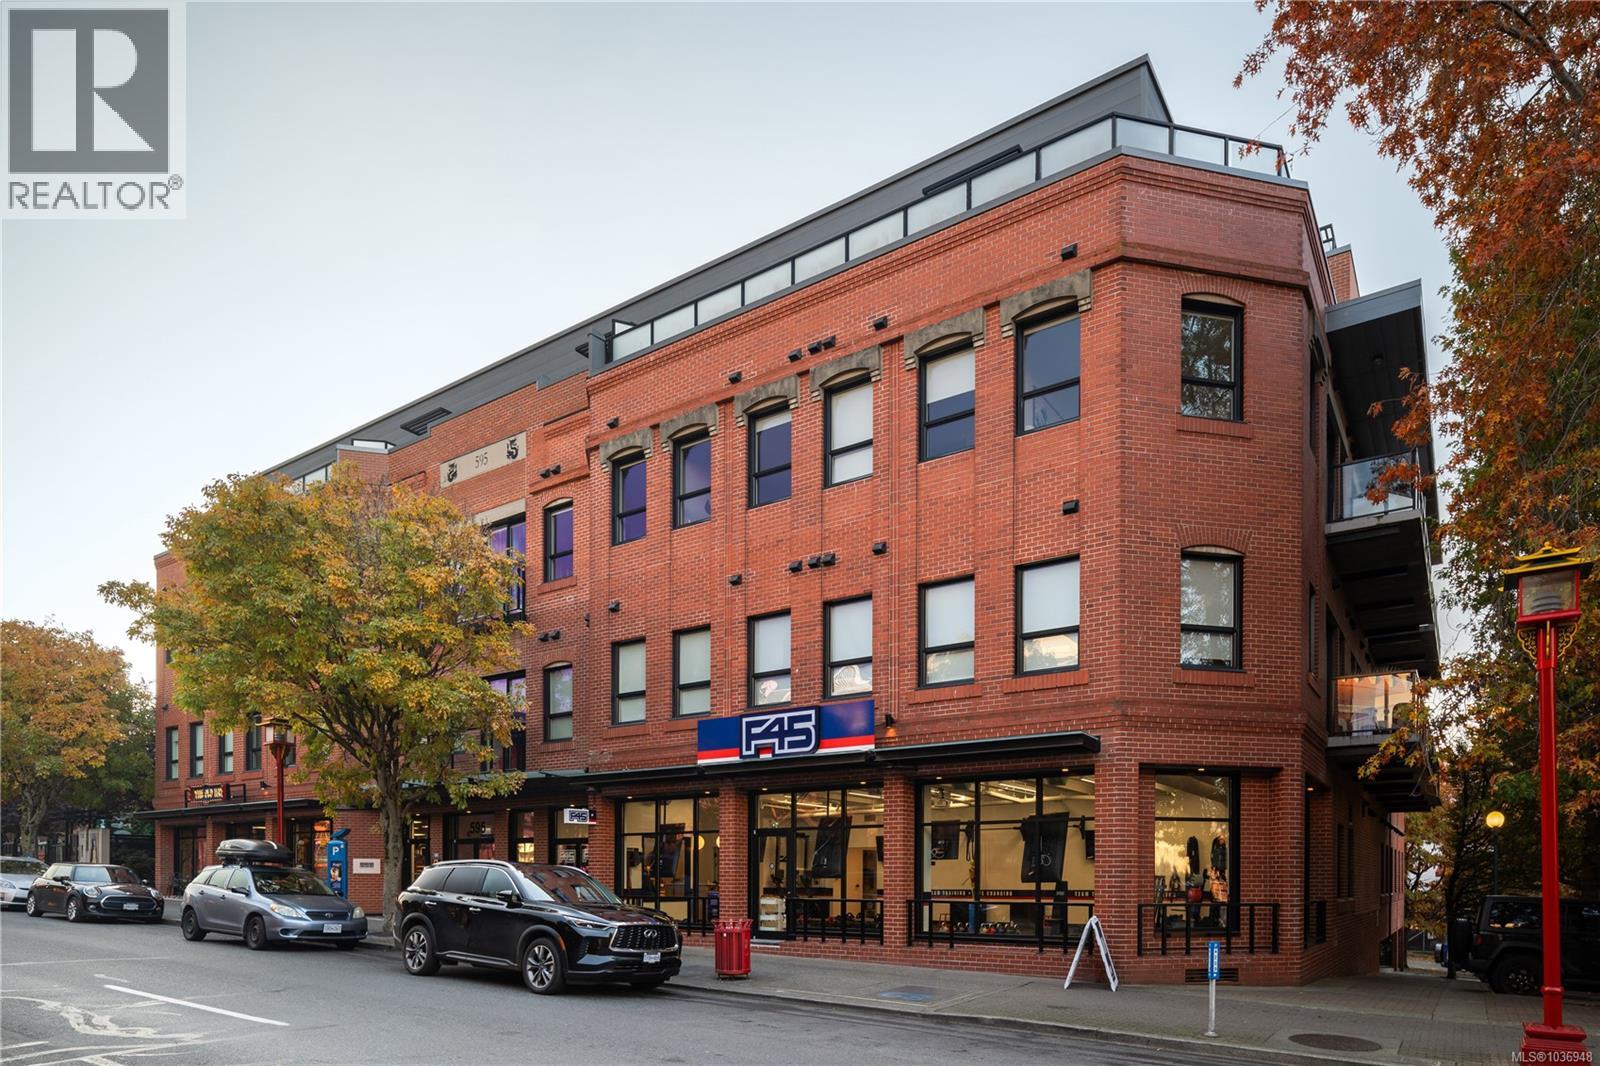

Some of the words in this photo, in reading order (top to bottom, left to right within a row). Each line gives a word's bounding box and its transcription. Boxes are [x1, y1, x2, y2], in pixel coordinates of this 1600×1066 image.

[474, 452, 489, 469] 595
[741, 709, 816, 757] F45
[568, 809, 589, 822] F45
[469, 821, 486, 834] 595
[332, 846, 340, 856] P
